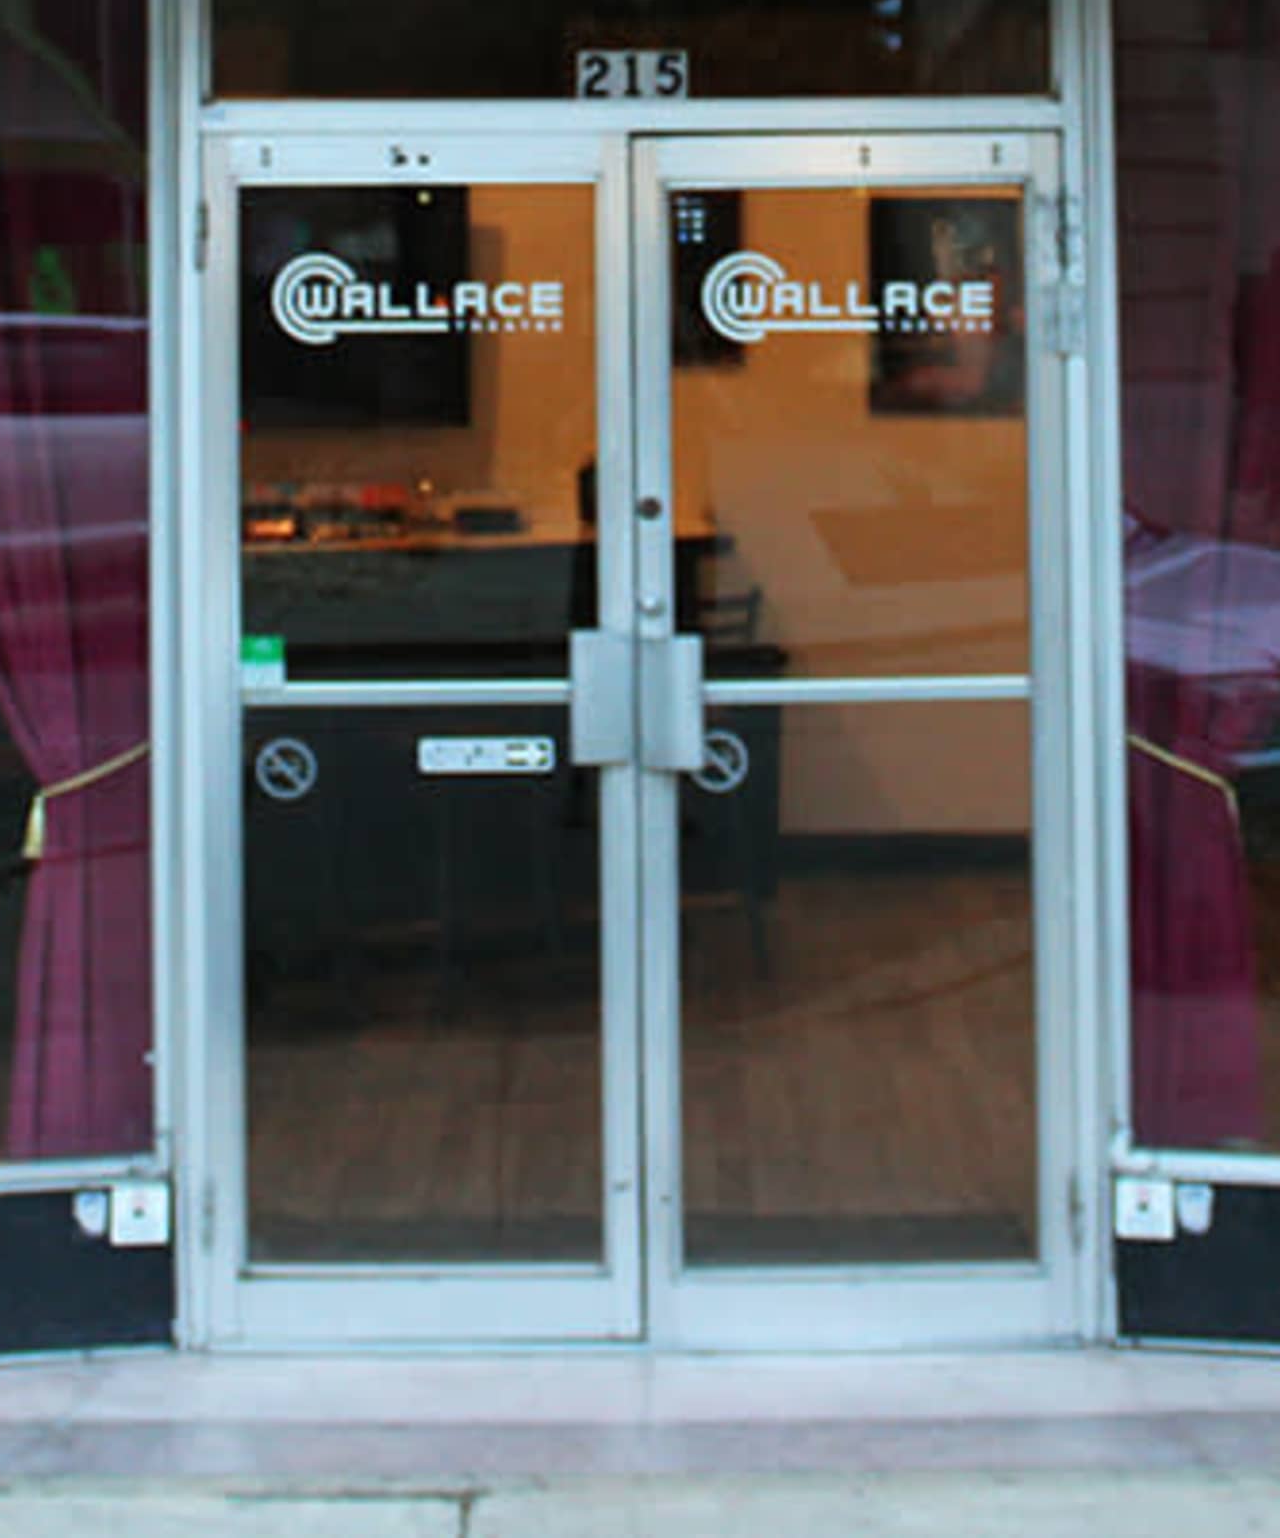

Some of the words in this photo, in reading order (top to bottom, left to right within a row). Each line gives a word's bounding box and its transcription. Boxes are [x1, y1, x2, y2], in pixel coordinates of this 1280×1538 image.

[582, 54, 683, 98] 215
[298, 281, 564, 317] WALLACE
[727, 281, 994, 317] WALLACE
